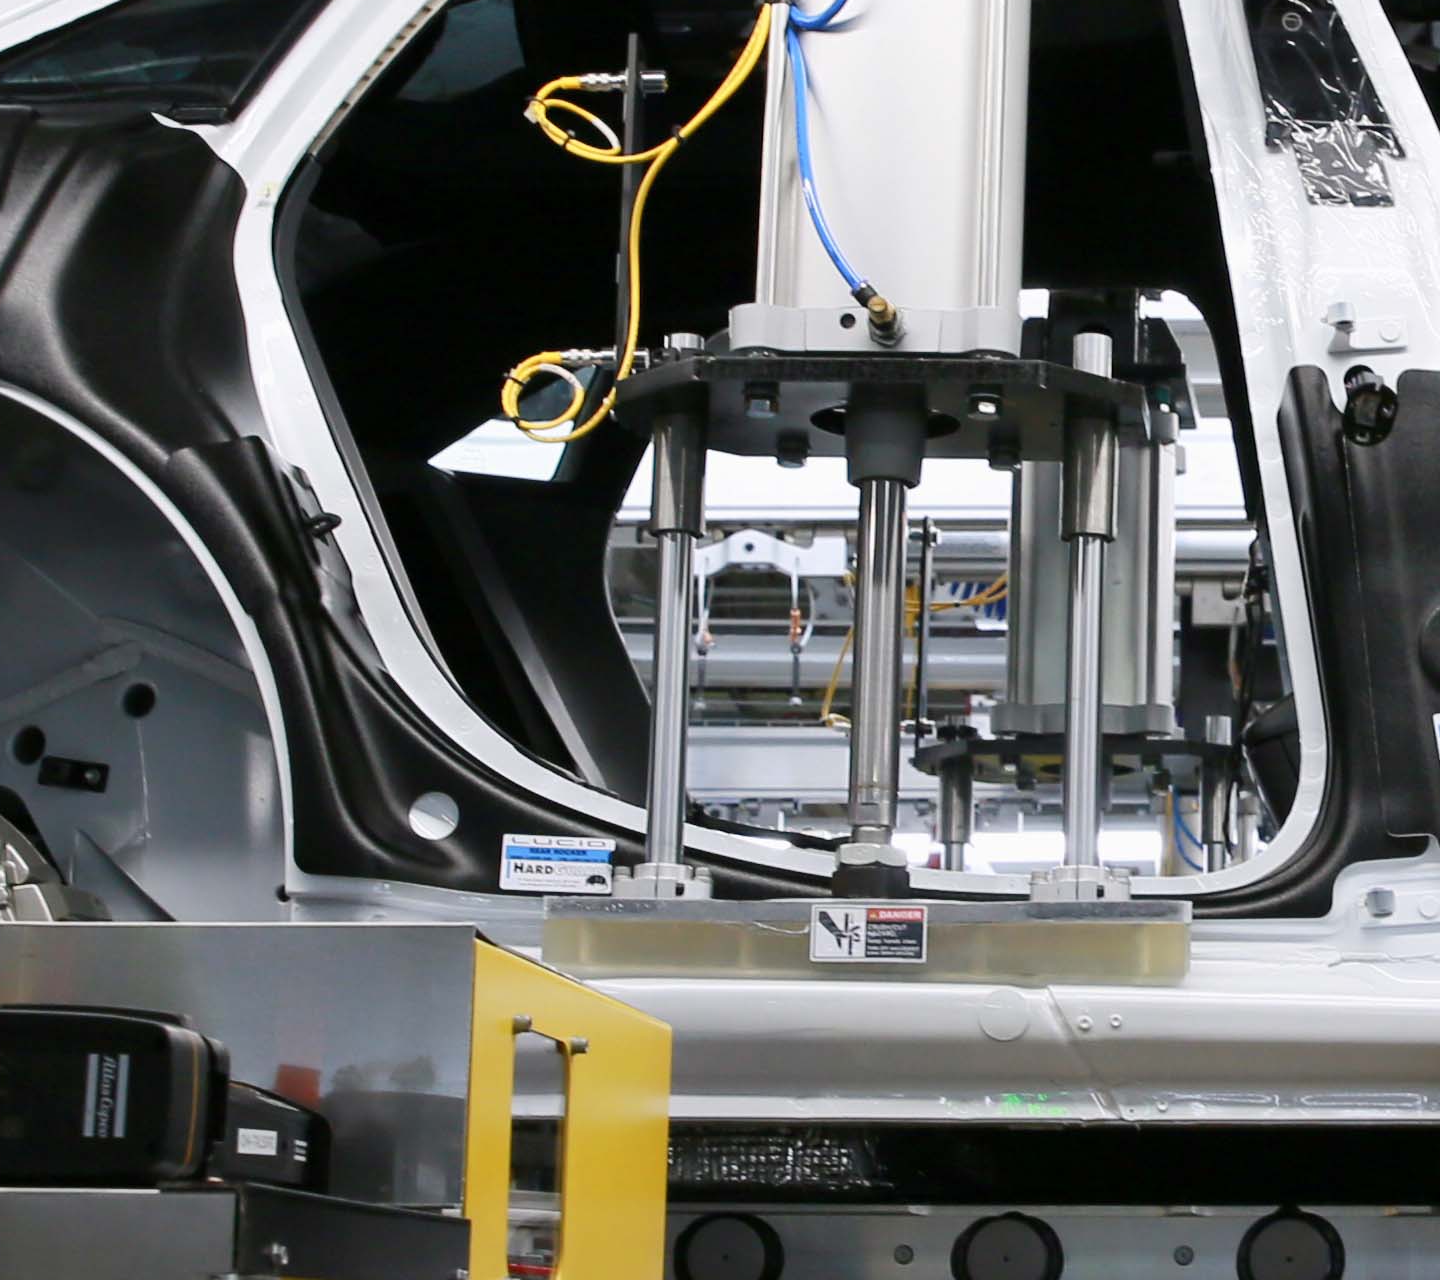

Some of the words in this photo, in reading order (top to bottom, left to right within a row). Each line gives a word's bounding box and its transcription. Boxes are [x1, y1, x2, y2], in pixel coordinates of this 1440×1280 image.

[511, 837, 606, 848] LUCID
[879, 910, 922, 920] DANGER
[102, 1055, 117, 1096] Atlas
